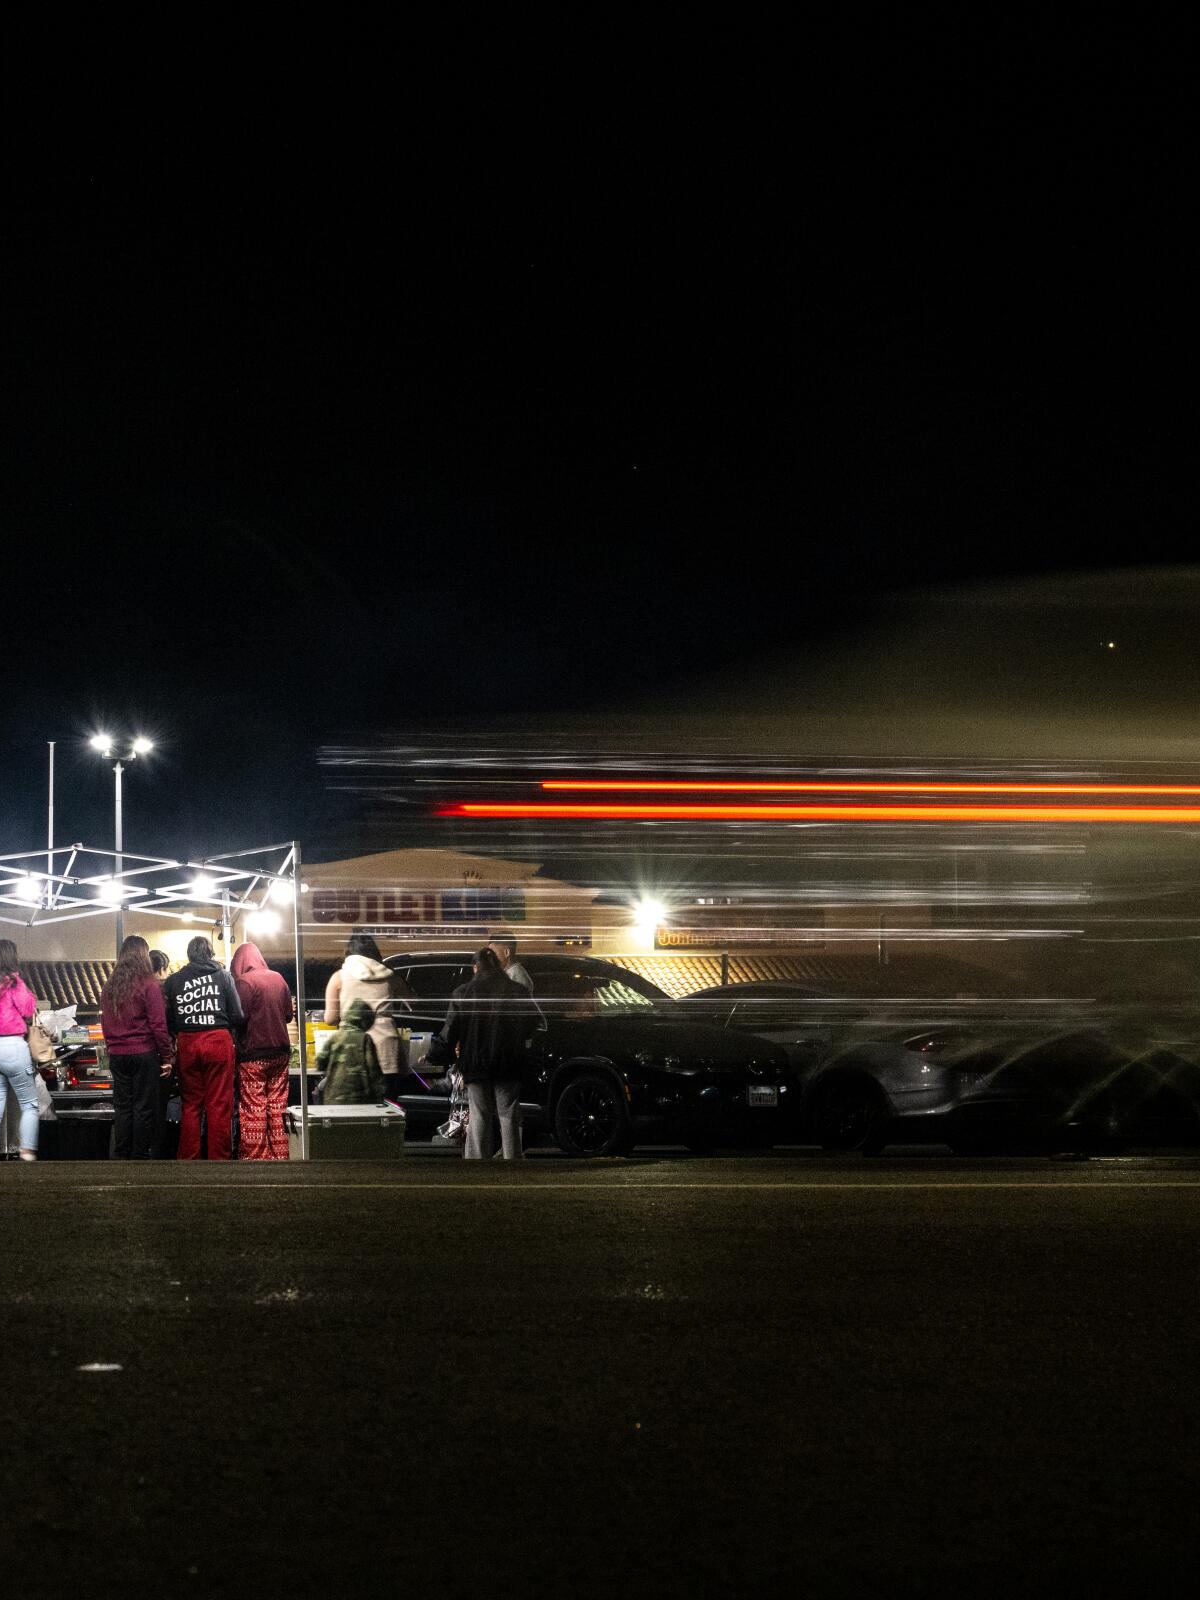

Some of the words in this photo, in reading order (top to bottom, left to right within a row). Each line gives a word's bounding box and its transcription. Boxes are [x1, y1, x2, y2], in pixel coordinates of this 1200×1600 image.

[361, 927, 476, 936] SUPERSTORE
[183, 974, 213, 991] ANTI
[175, 985, 221, 1004] SOCIAL
[177, 998, 222, 1015] SOCIAL
[184, 1014, 216, 1025] CLUB
